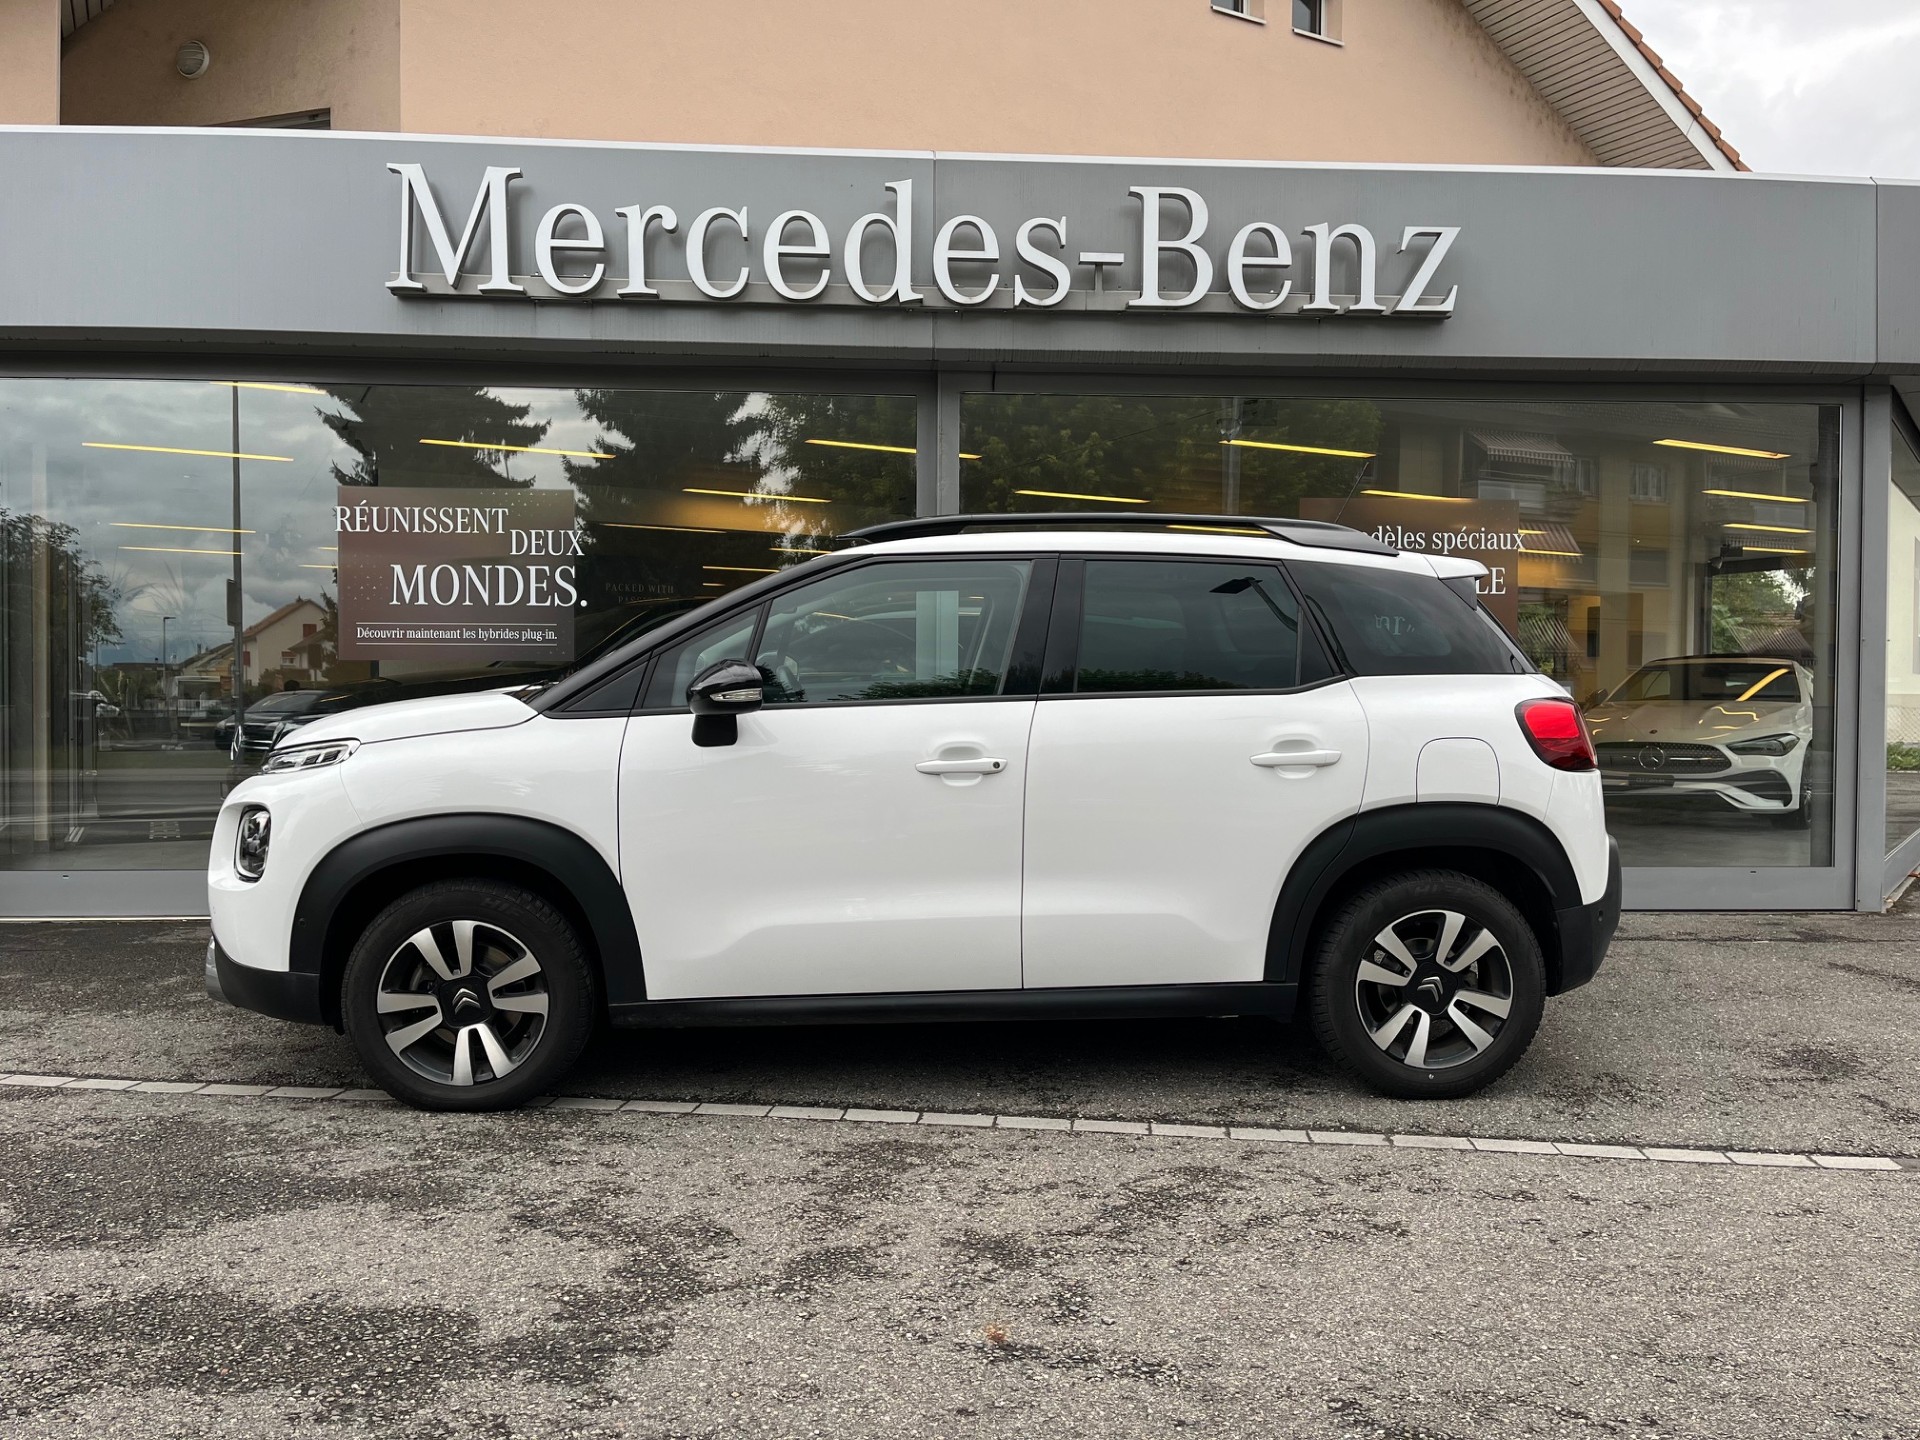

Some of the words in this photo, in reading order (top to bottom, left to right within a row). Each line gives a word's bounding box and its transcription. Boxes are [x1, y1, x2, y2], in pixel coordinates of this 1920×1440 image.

[385, 161, 1462, 319] Mercedes-Benz
[335, 500, 509, 535] RÉUNISSENT
[509, 529, 585, 557] DEUX
[1363, 525, 1426, 550] dèles
[1431, 526, 1526, 555] spéciaux
[389, 563, 588, 609] MONDES.
[605, 583, 645, 593] PACKED
[648, 583, 674, 594] WITH
[356, 626, 405, 639] Découvrir
[406, 628, 461, 640] maintenant
[462, 628, 476, 640] les
[478, 628, 520, 641] hybrides
[521, 628, 558, 642] plug-in.
